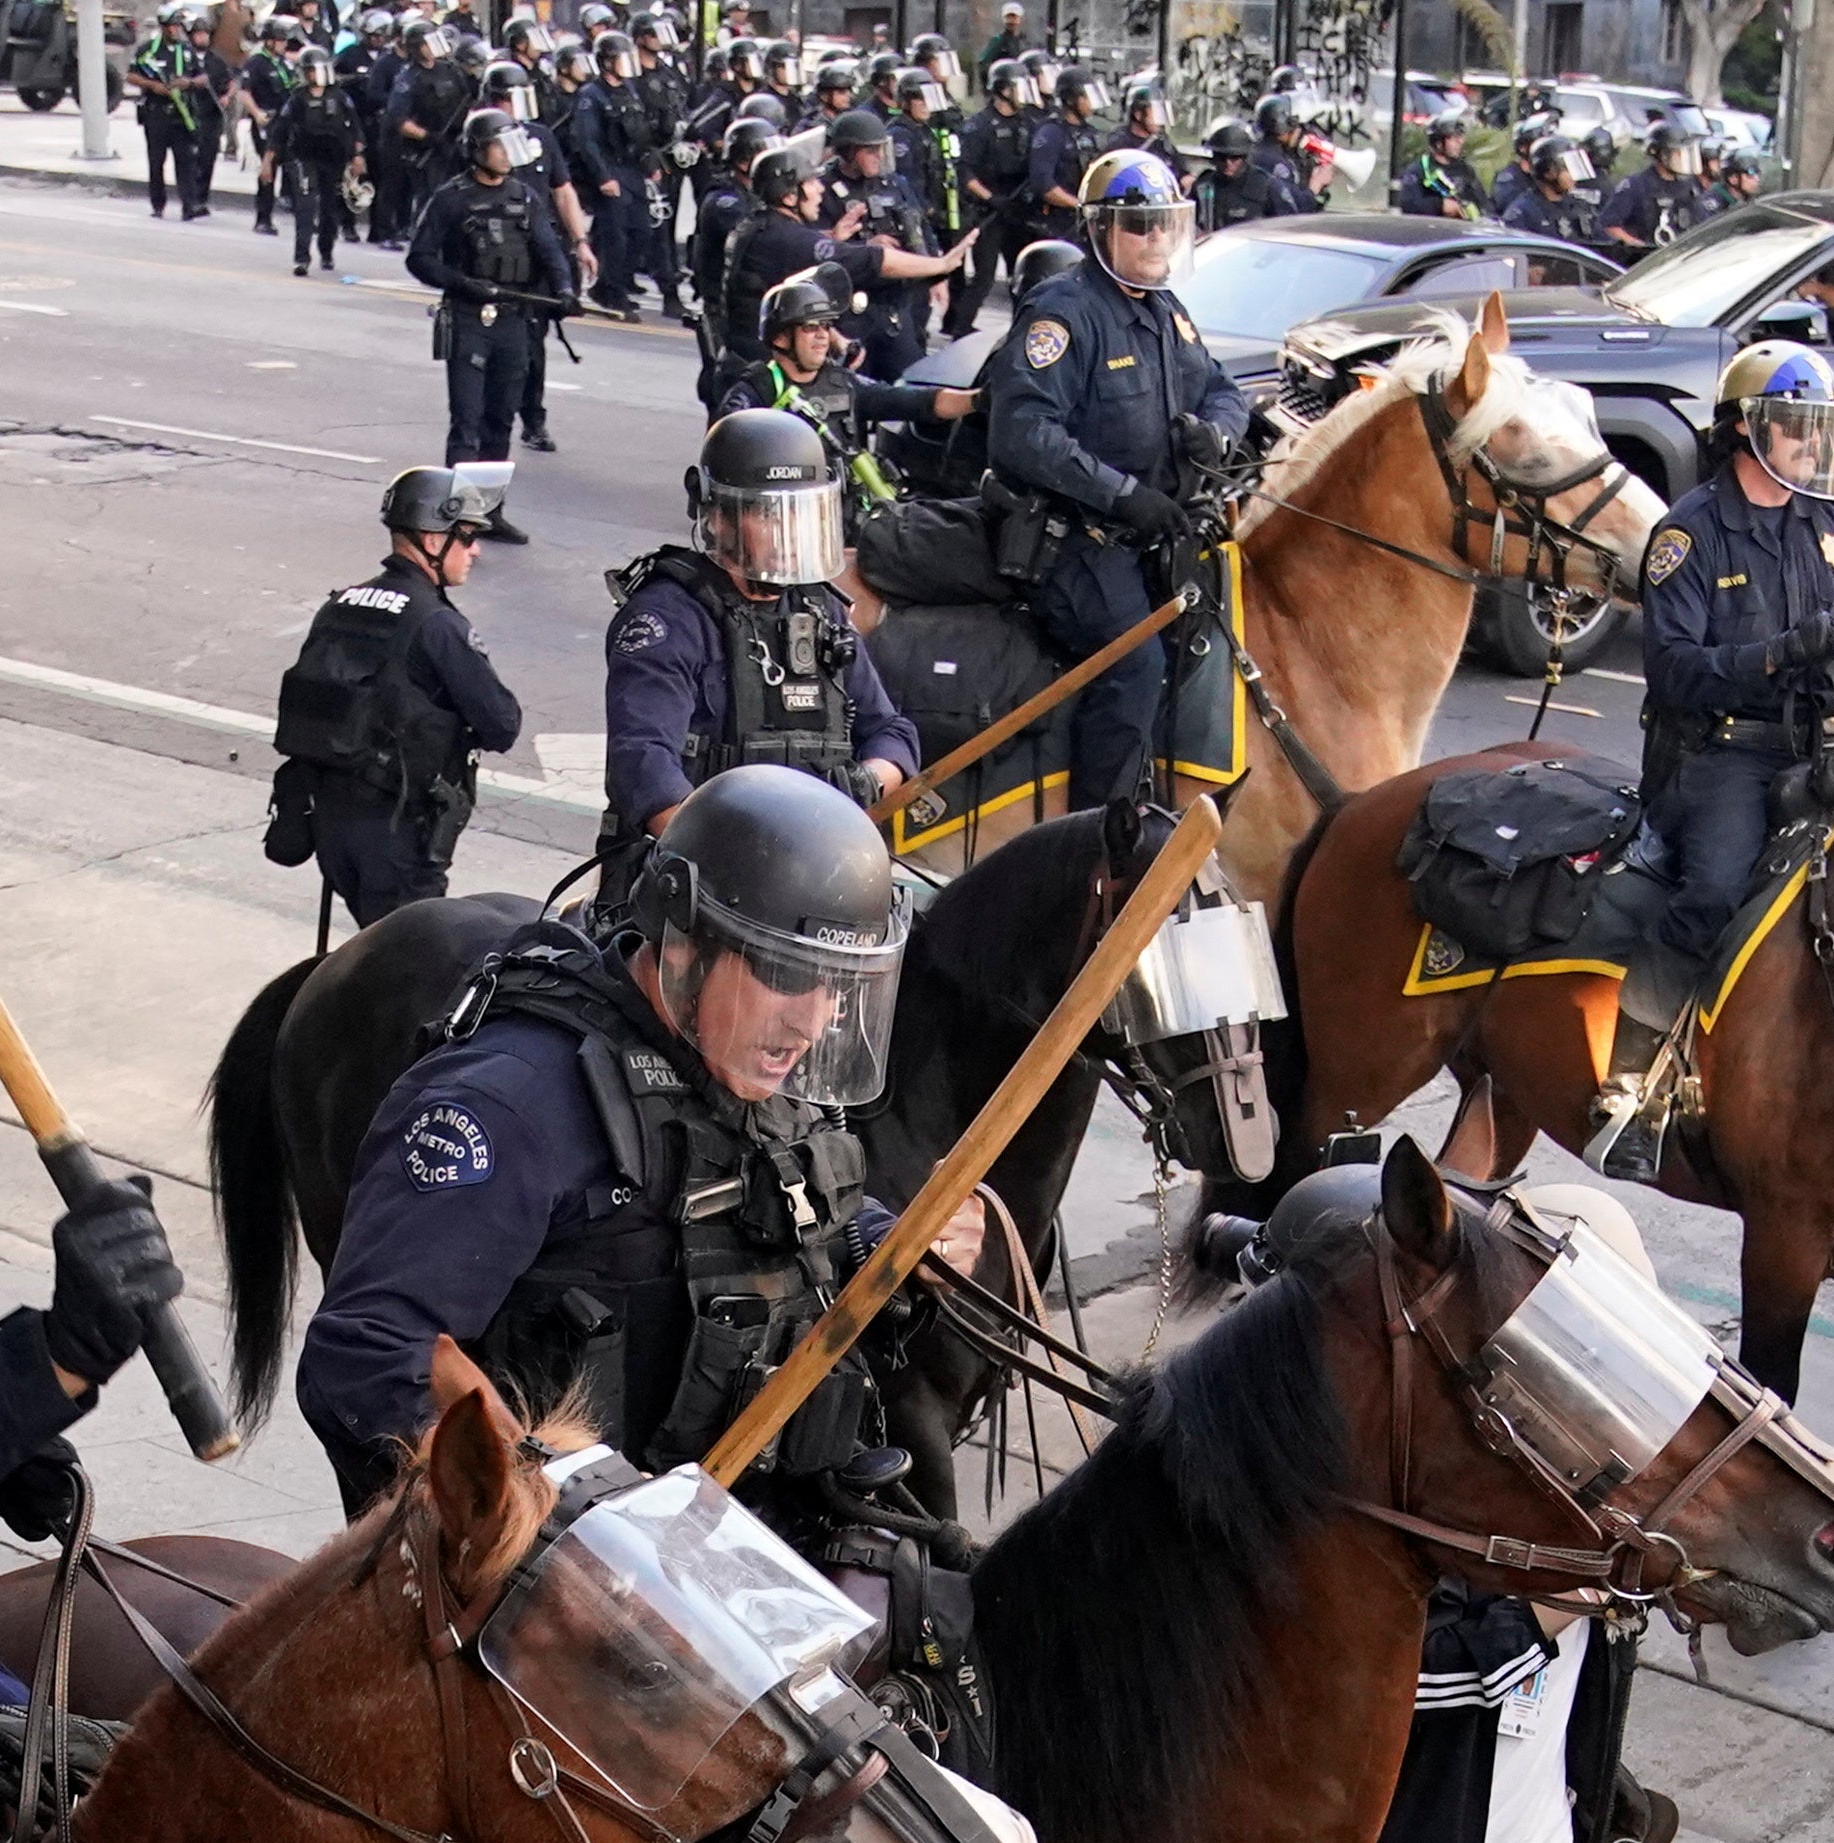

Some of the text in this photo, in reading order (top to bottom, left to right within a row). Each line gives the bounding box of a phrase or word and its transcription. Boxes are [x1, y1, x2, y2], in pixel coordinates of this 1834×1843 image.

[766, 466, 803, 479] JORDAN
[336, 587, 411, 614] POLICE
[787, 695, 816, 707] POLICE
[629, 1055, 652, 1069] LOS
[404, 1107, 489, 1170] LOS ANGELES
[416, 1131, 466, 1159] METRO
[407, 1150, 459, 1183] POLICE
